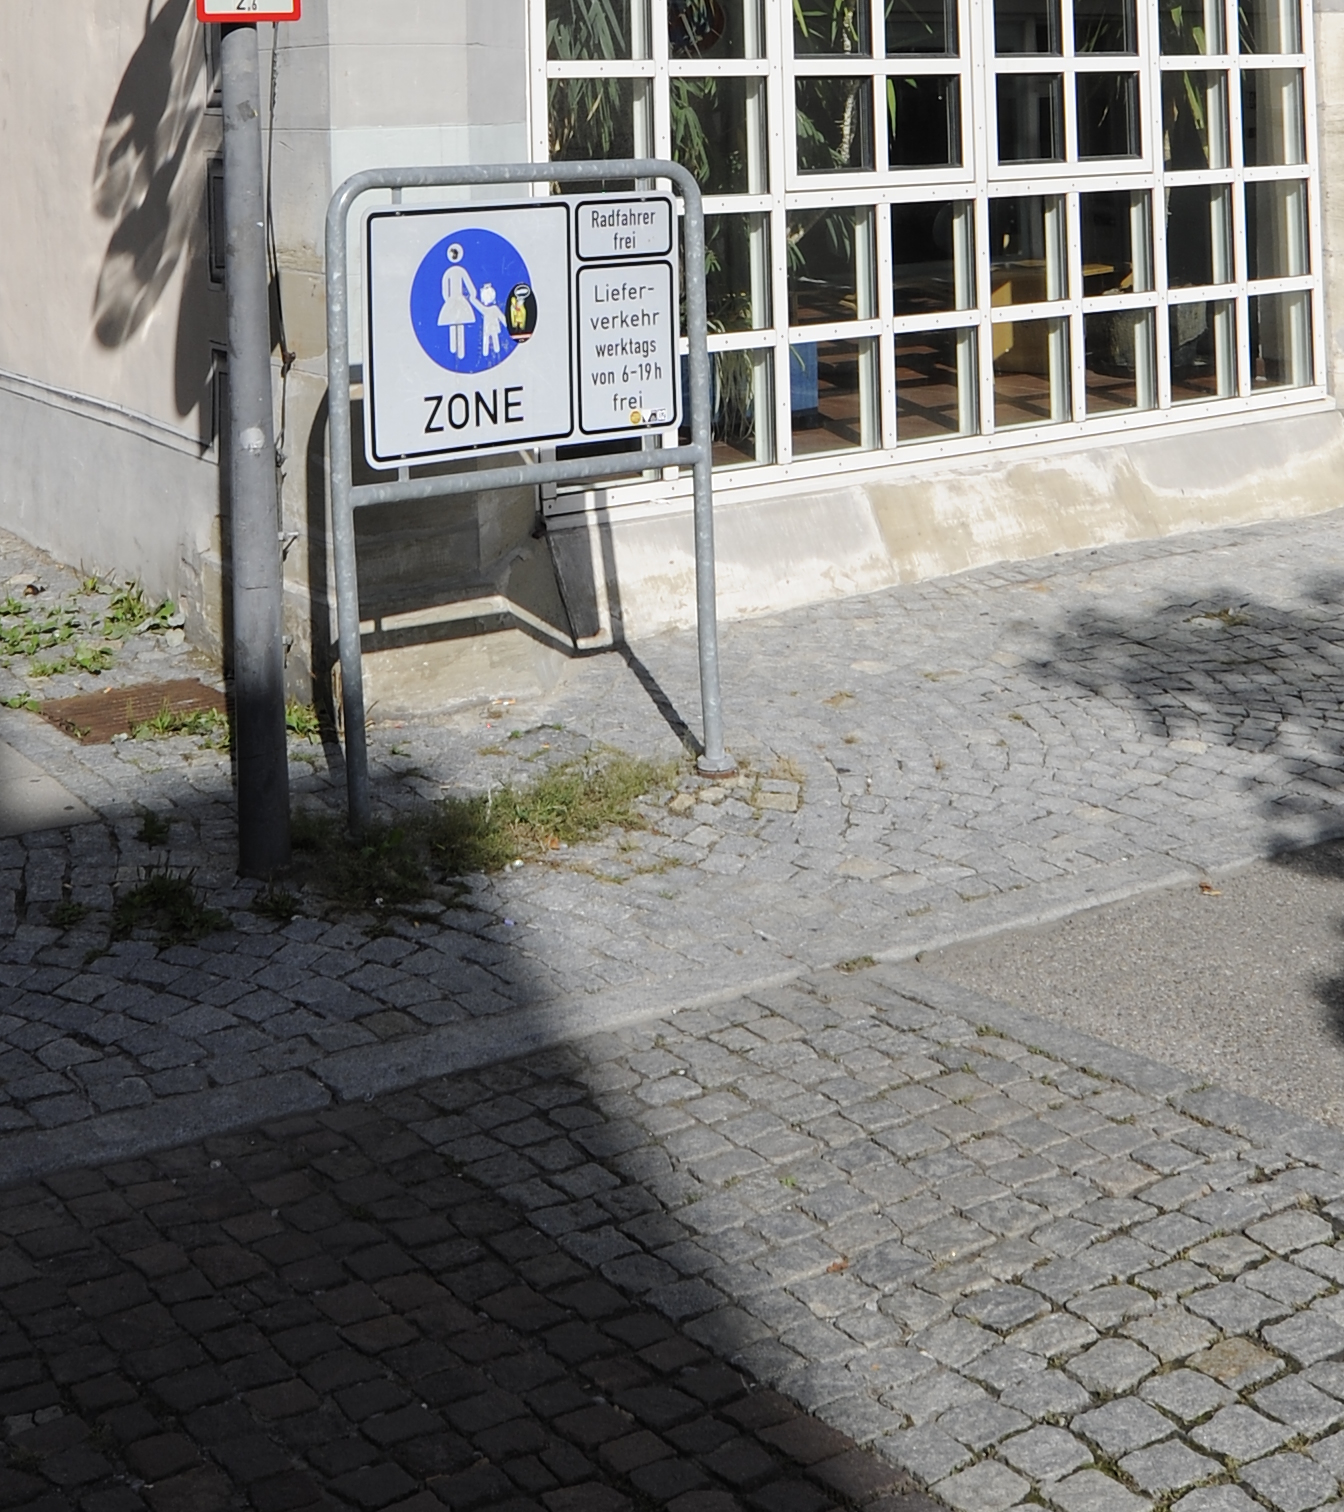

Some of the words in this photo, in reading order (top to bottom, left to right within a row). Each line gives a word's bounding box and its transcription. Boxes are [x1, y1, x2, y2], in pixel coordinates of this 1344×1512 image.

[590, 208, 656, 229] Radfahrer
[613, 230, 637, 250] frei
[594, 282, 655, 303] Liefer-
[590, 308, 660, 330] verkehr
[595, 338, 657, 358] werktags
[591, 370, 615, 386] von
[423, 386, 525, 434] ZONE
[613, 391, 643, 412] frei
